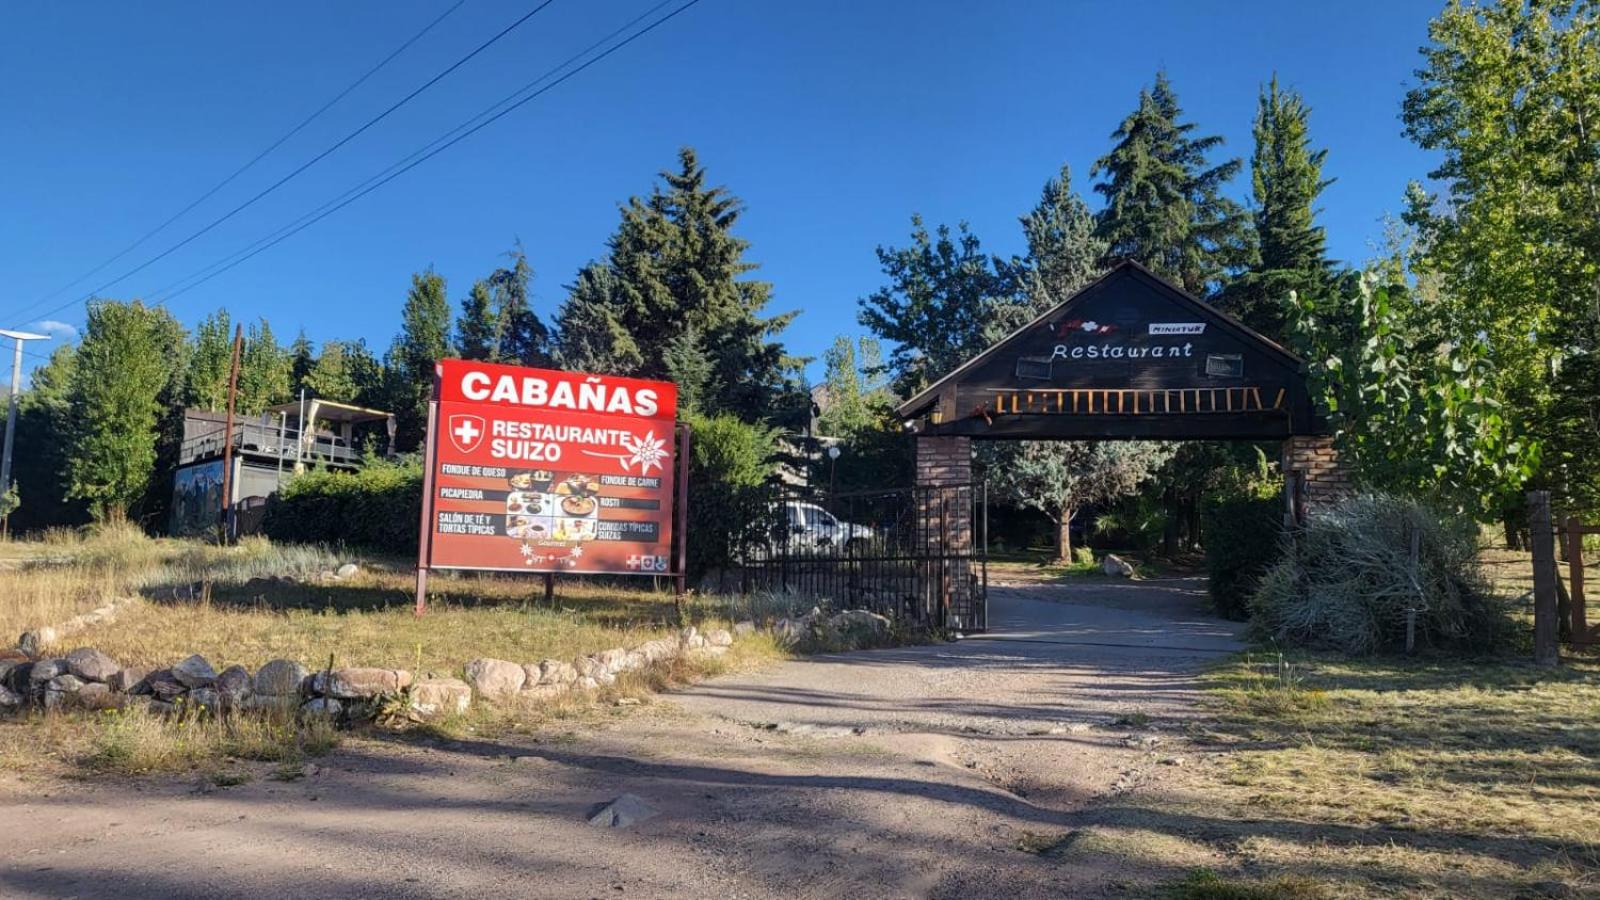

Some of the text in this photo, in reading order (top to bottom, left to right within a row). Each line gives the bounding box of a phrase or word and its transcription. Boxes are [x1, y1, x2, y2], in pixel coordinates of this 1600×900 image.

[1051, 342, 1193, 359] Restaurant
[461, 371, 658, 417] CABAÑAS
[491, 419, 632, 447] RESTAURANTE
[490, 438, 561, 462] SUIZO
[442, 464, 506, 477] FONDUE DE QUESO
[601, 475, 659, 488] FONDUE DE CARNE
[441, 488, 484, 499] PICAPIEDRA
[464, 514, 474, 524] DE
[486, 516, 492, 525] Y
[439, 523, 466, 534] TORTAS
[598, 522, 628, 532] COMIDAS
